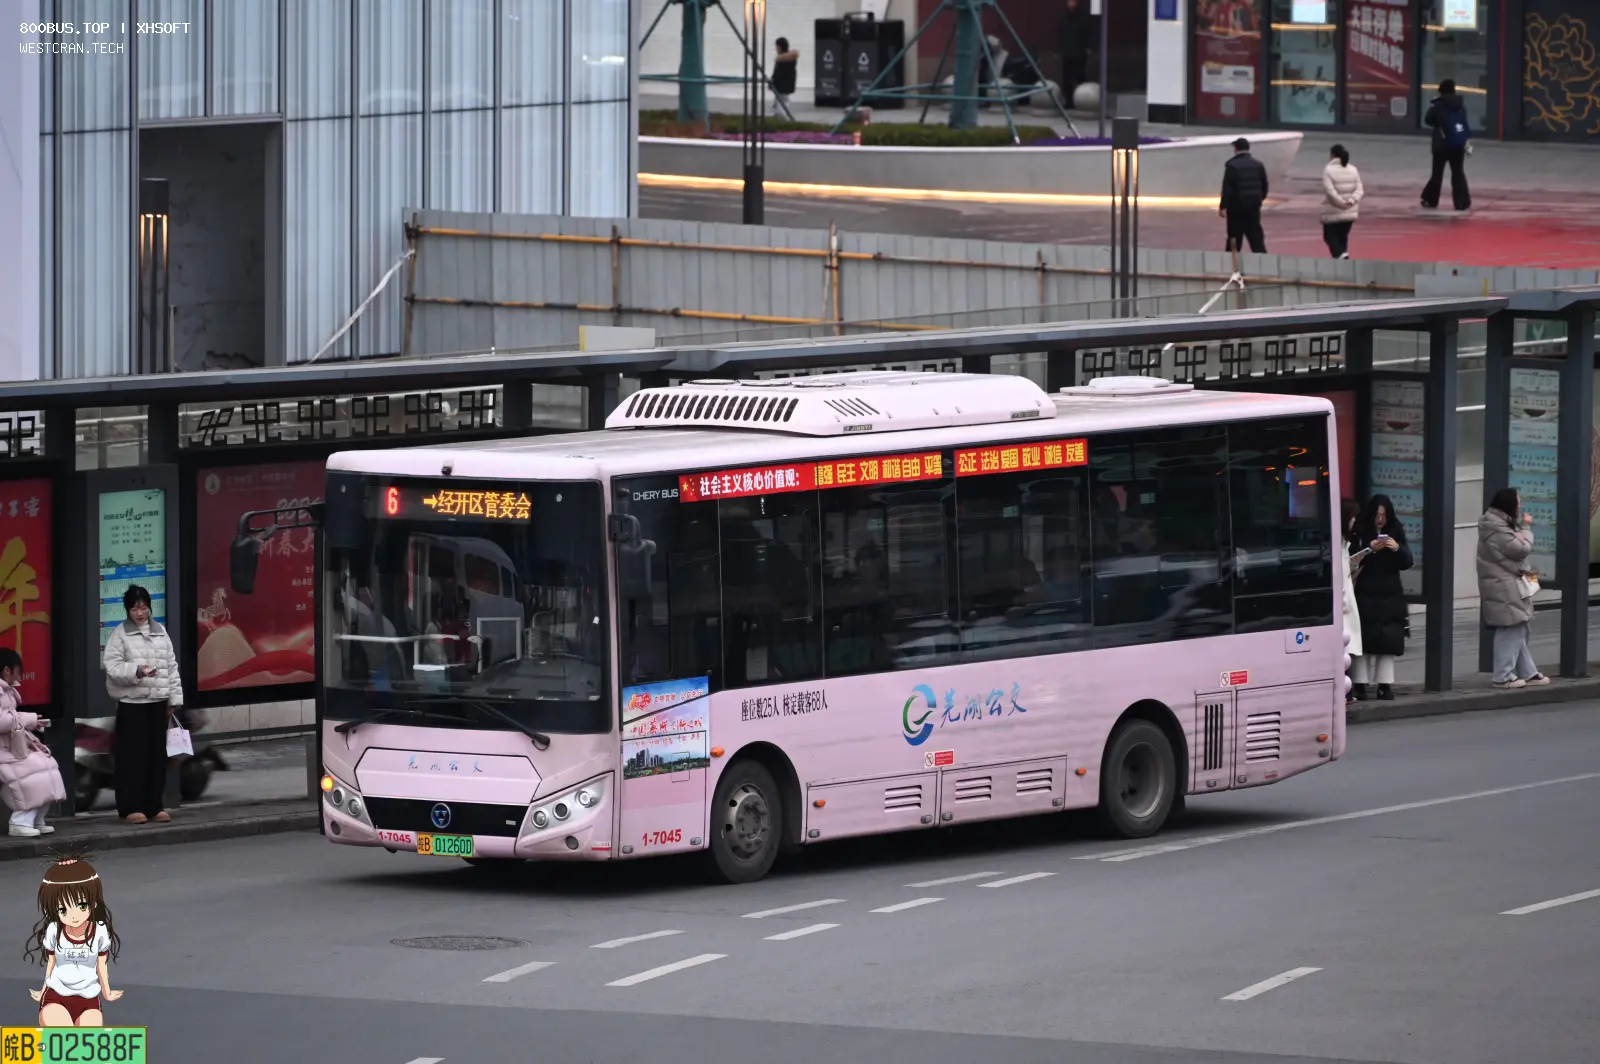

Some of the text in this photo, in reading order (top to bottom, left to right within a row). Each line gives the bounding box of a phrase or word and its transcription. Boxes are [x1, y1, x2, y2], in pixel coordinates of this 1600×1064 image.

[633, 488, 679, 501] CHERY BUS
[700, 468, 800, 497] 社会主义核心价值观：
[384, 486, 399, 516] 6
[437, 489, 532, 519] 经开区管委会
[741, 689, 828, 721] 座位数25人 核定载客68人
[940, 681, 1028, 728] 芜湖公交
[378, 831, 412, 844] 1-7045
[642, 828, 682, 847] 1-7045
